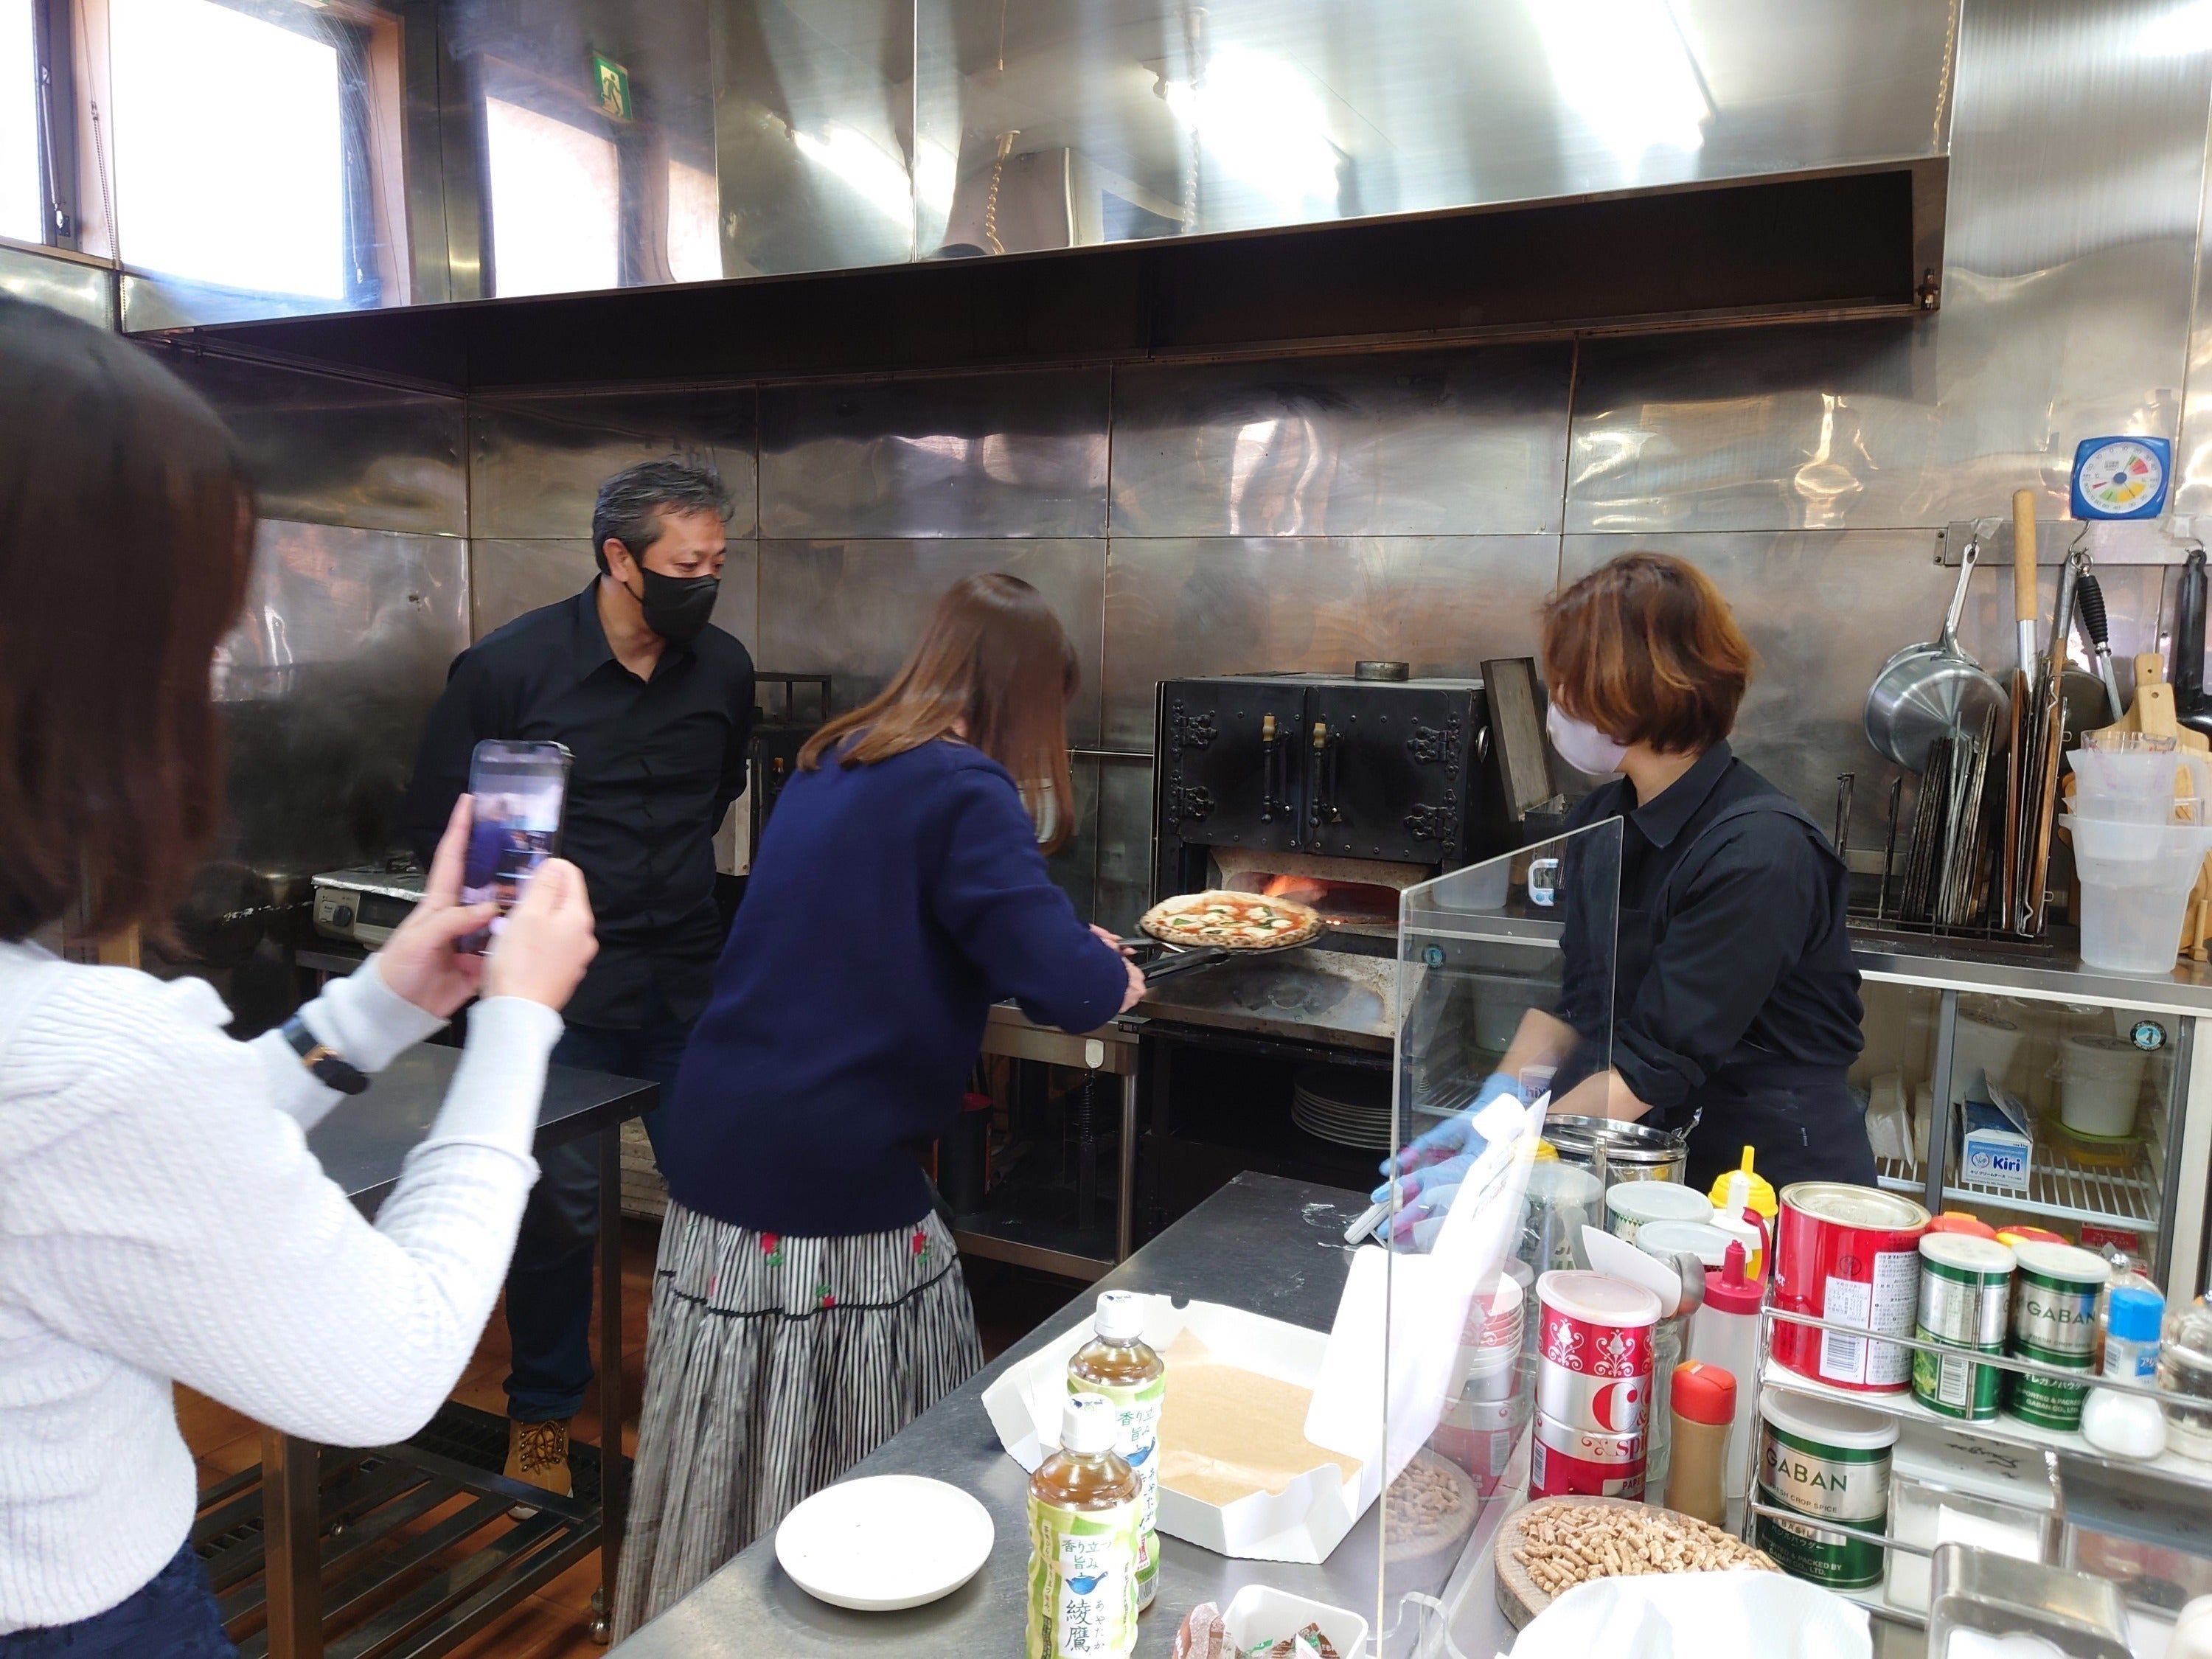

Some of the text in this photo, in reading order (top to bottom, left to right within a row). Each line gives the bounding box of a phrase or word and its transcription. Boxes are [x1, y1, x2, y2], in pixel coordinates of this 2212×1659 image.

[1993, 1155, 2021, 1172] Kiri
[2028, 1301, 2097, 1325] GABAN
[1767, 1447, 1848, 1492] GABAN
[1790, 1495, 1812, 1506] CROP
[1814, 1503, 1837, 1513] SPICE
[1062, 1539, 1112, 1554] 香り立つ
[1074, 1555, 1099, 1570] 旨み
[1798, 1555, 1830, 1570] PACKED
[1831, 1562, 1842, 1571] BY
[1809, 1565, 1826, 1576] LTD.
[1065, 1599, 1093, 1652] 綾鷹
[1094, 1600, 1105, 1650] あやたか
